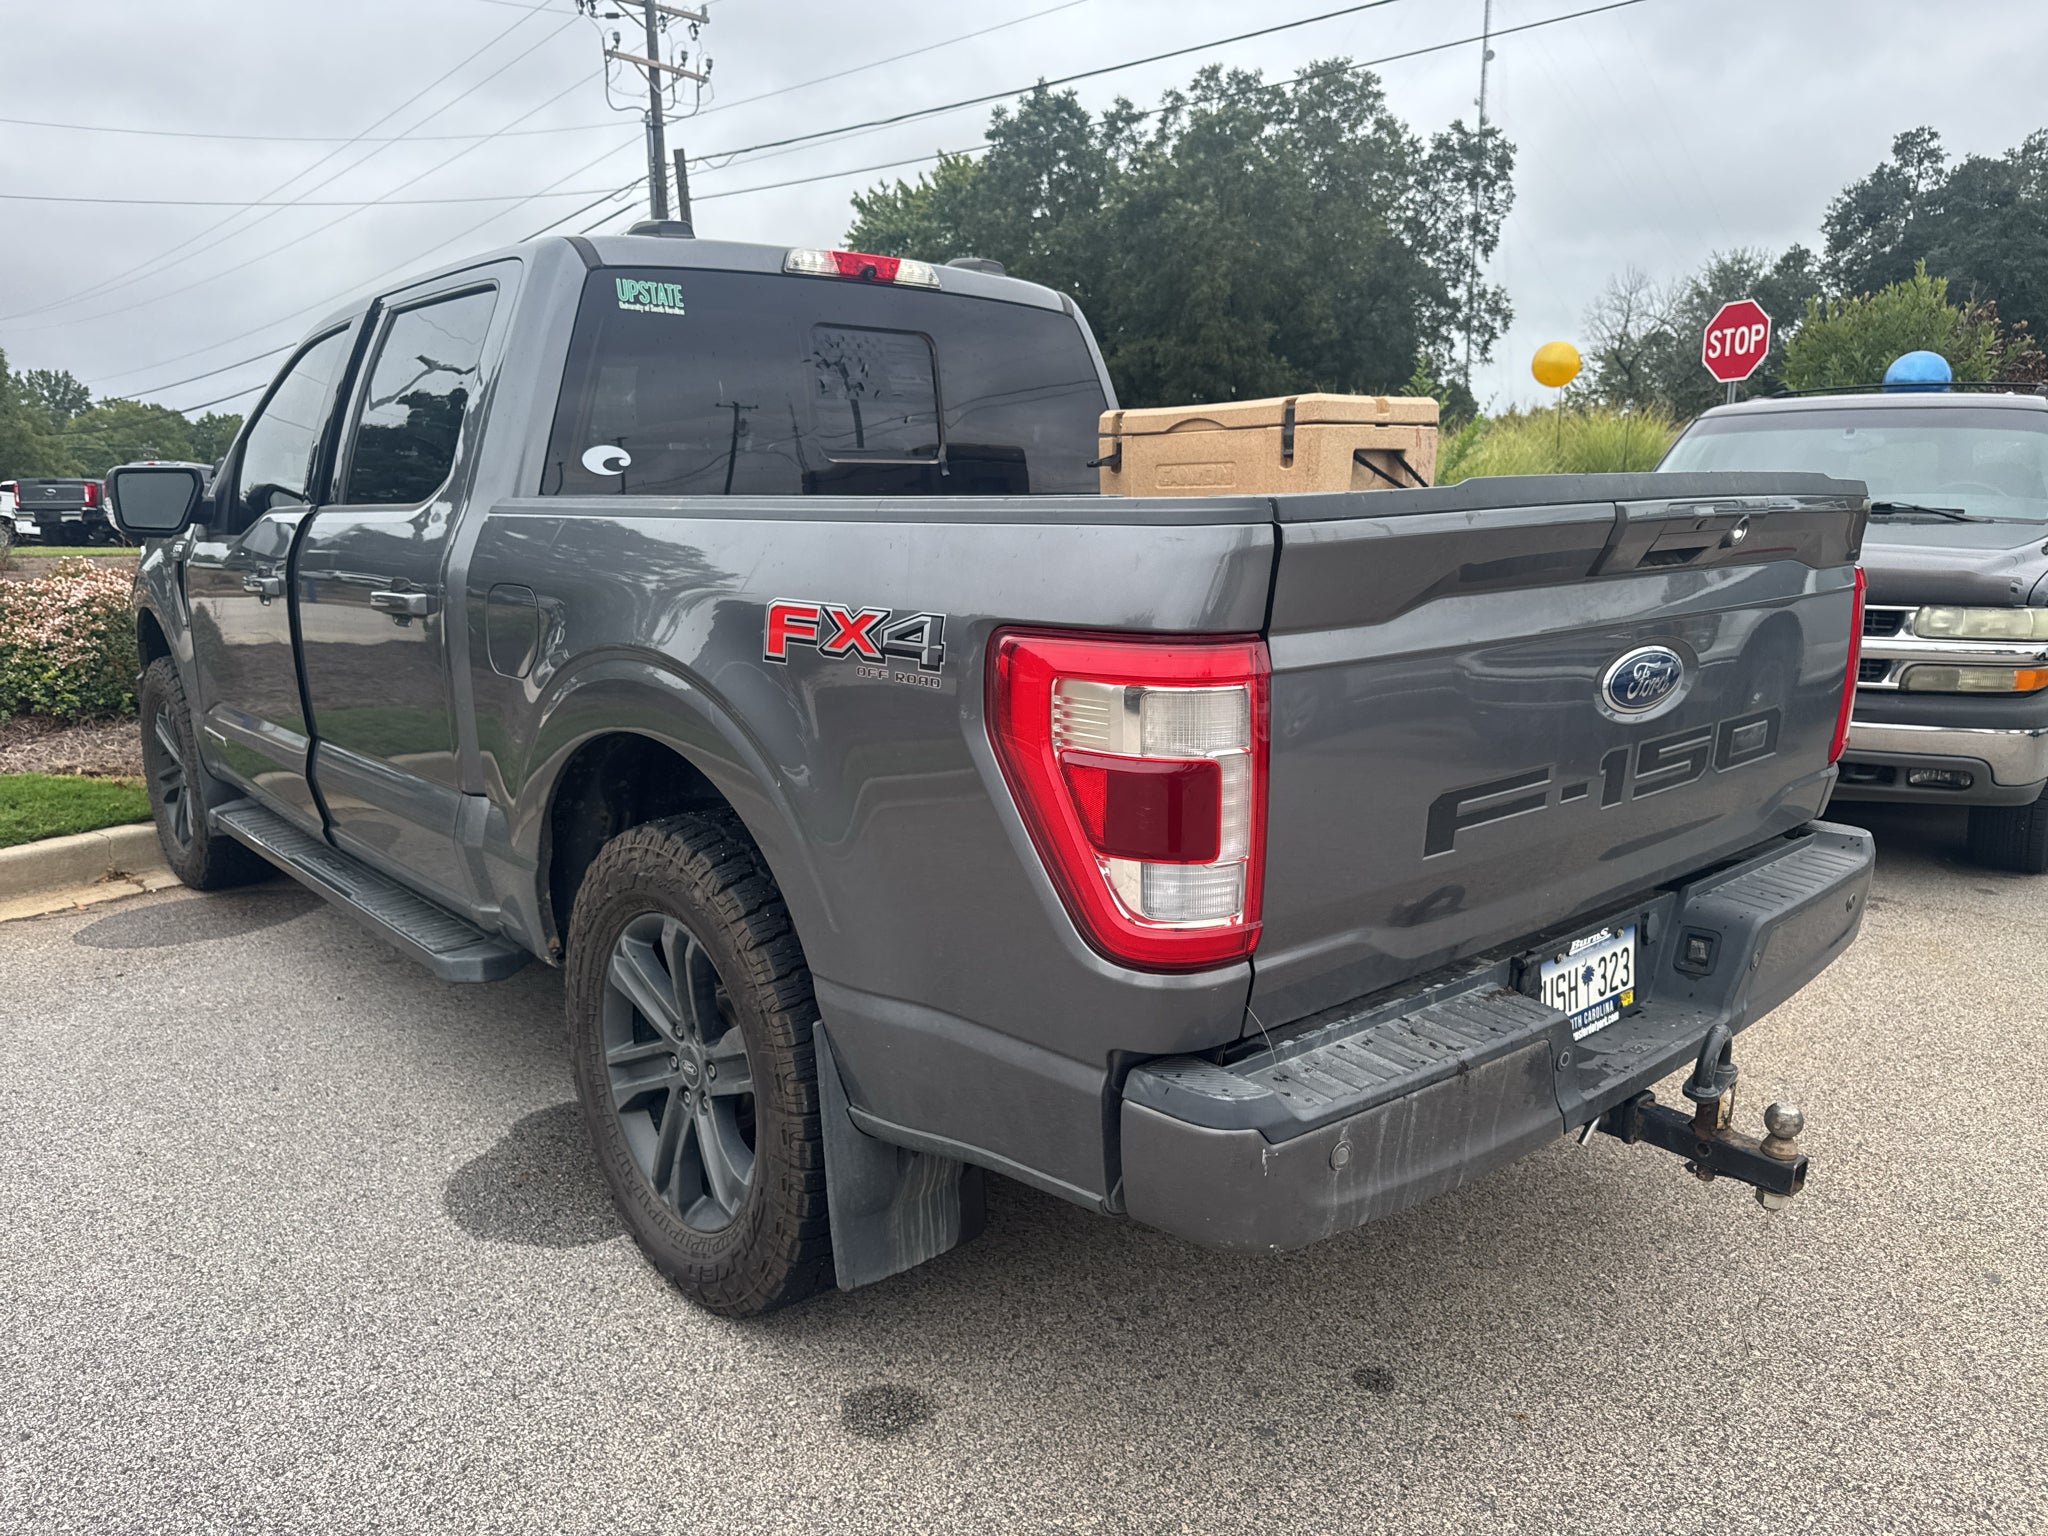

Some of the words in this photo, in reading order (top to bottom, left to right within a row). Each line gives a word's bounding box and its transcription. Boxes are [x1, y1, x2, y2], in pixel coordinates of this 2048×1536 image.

[616, 278, 684, 308] UPSTATE
[1708, 323, 1765, 359] STOP
[763, 597, 946, 674] FX4
[856, 666, 889, 680] OFF
[895, 671, 942, 689] ROAD
[1626, 660, 1672, 700] Ford
[1422, 704, 1783, 861] F-150
[1570, 927, 1610, 953] Burns
[1598, 947, 1630, 997] 323
[1583, 1000, 1614, 1025] CAROLINA
